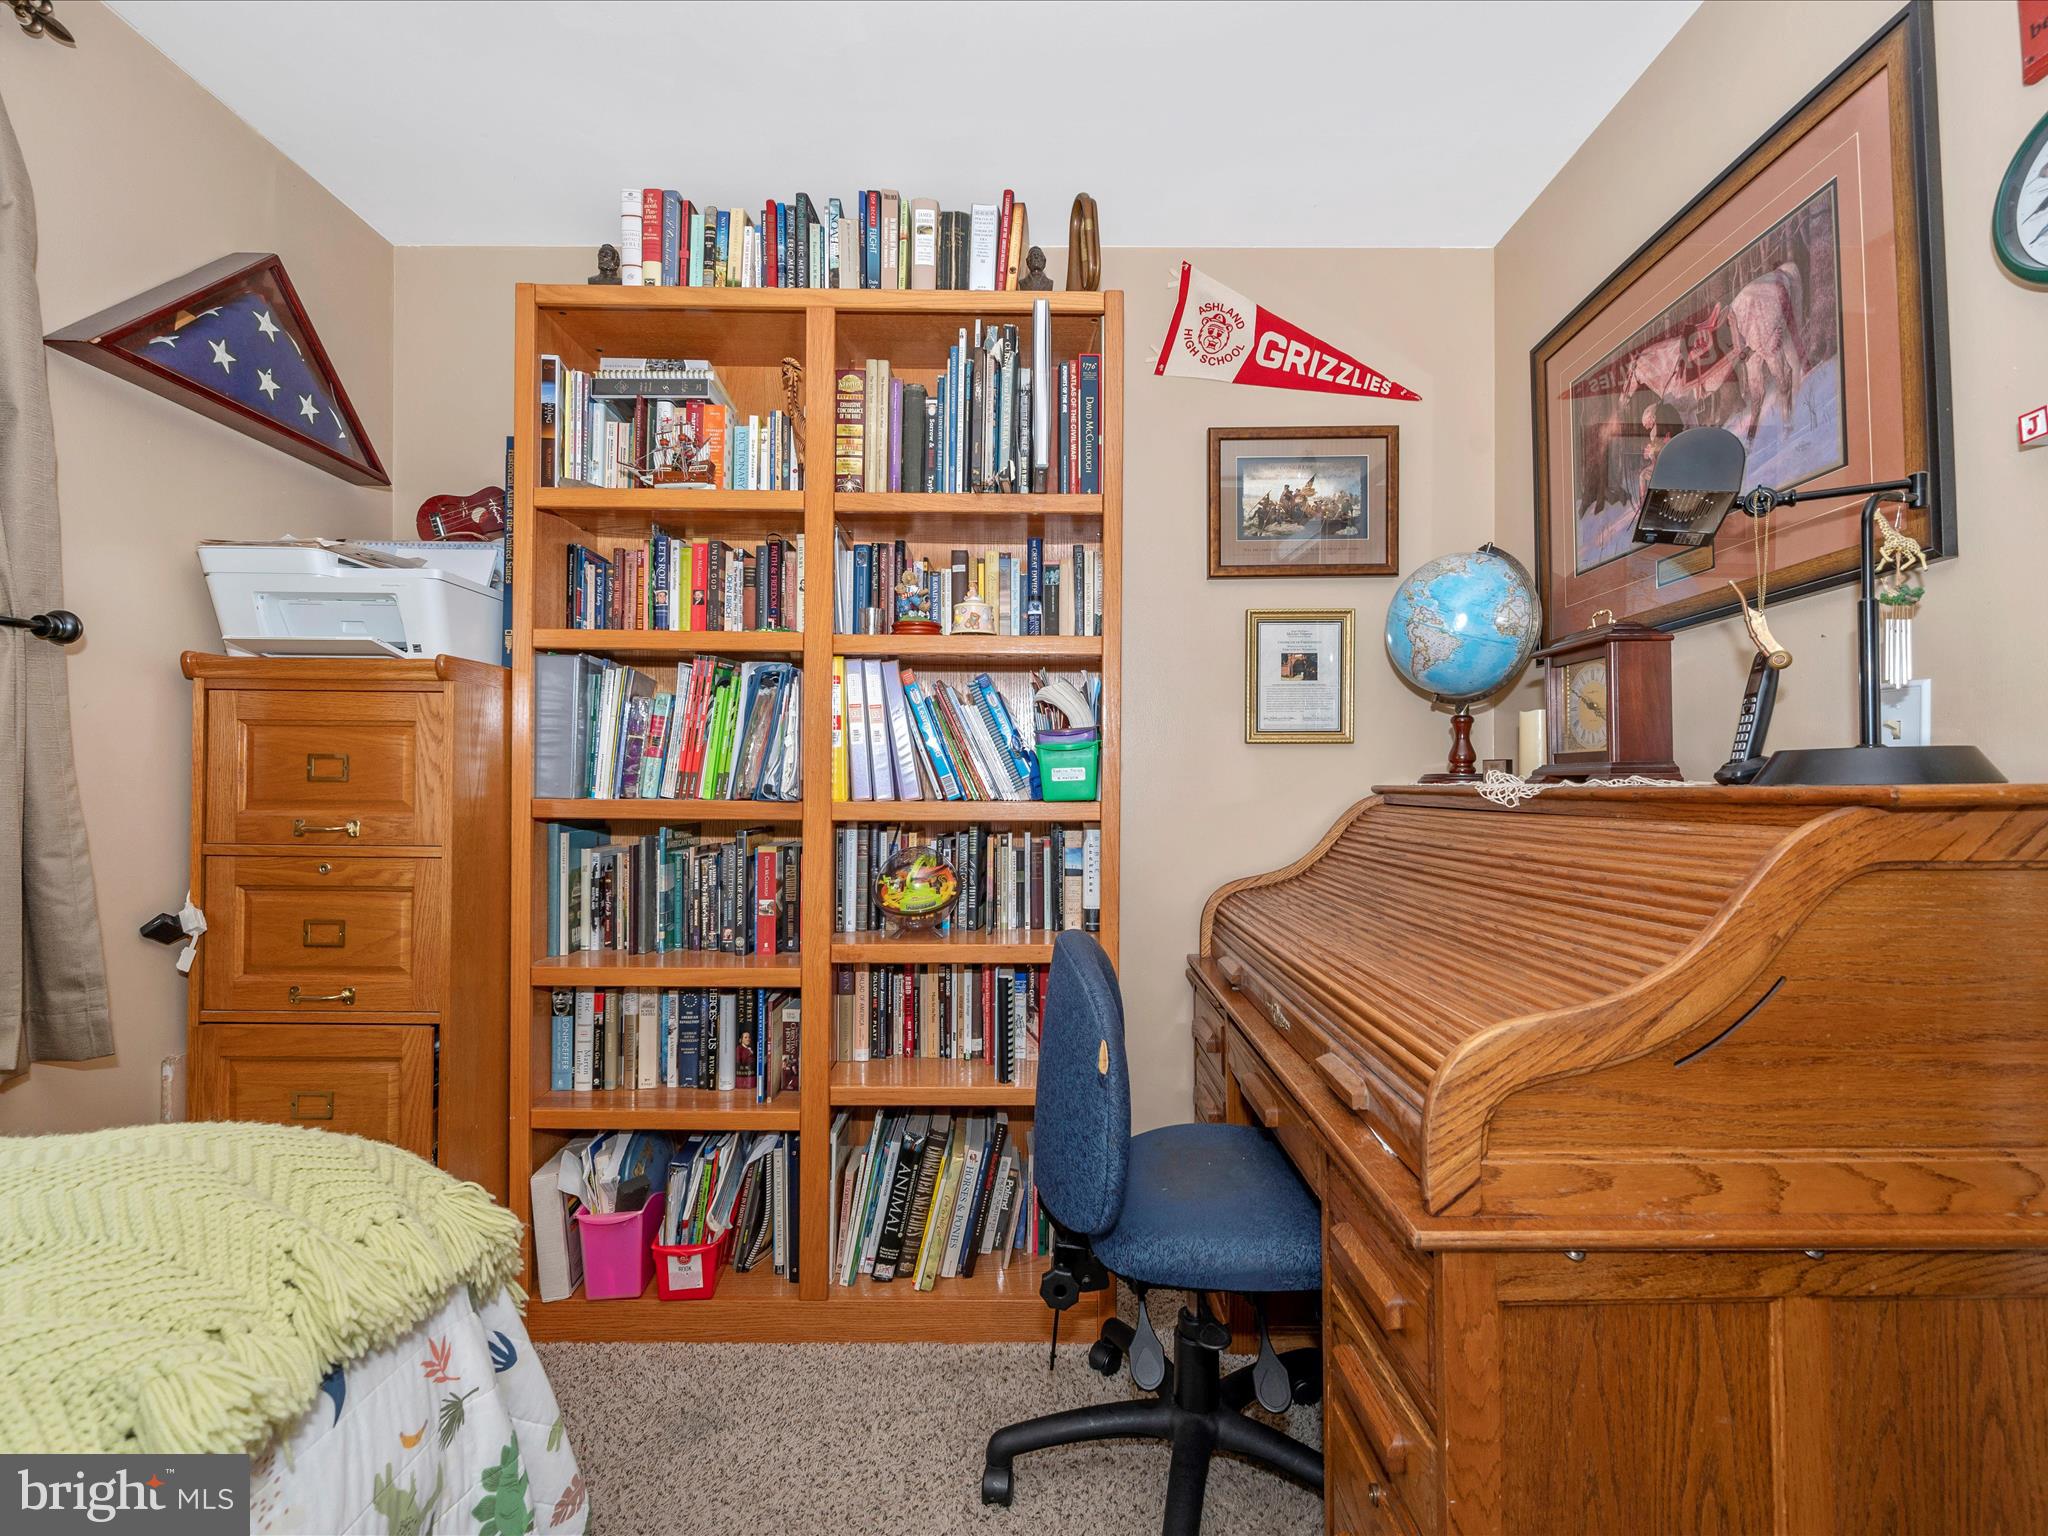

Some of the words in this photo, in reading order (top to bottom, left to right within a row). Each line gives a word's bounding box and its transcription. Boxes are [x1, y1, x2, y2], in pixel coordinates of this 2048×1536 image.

[869, 228, 877, 254] FLIGHT
[1199, 302, 1245, 329] ASHLAND
[1184, 328, 1199, 356] HIGH
[1200, 345, 1245, 366] SCHOOL
[1255, 330, 1392, 395] GRIZZLIES
[1070, 398, 1076, 407] OF
[2027, 414, 2040, 437] J
[938, 440, 942, 448] OF
[658, 541, 666, 562] LET'S
[658, 564, 666, 588] ROLL!
[701, 882, 708, 892] My
[786, 864, 796, 902] EISENHOWER
[709, 988, 717, 1020] HEROES
[701, 1029, 705, 1037] WE
[709, 1038, 716, 1050] US
[917, 1146, 942, 1194] CHARACTER
[742, 1178, 752, 1196] BEFORE
[883, 1178, 891, 1197] CREATION
[958, 1166, 975, 1202] HORSES
[1001, 1179, 1014, 1211] Poland
[884, 1162, 912, 1234] ANIMAL
[957, 1204, 965, 1212] &
[737, 1204, 746, 1227] HISTORY
[777, 1210, 781, 1218] OF
[906, 1194, 929, 1238] SKETCHES
[949, 1215, 964, 1249] PONIES
